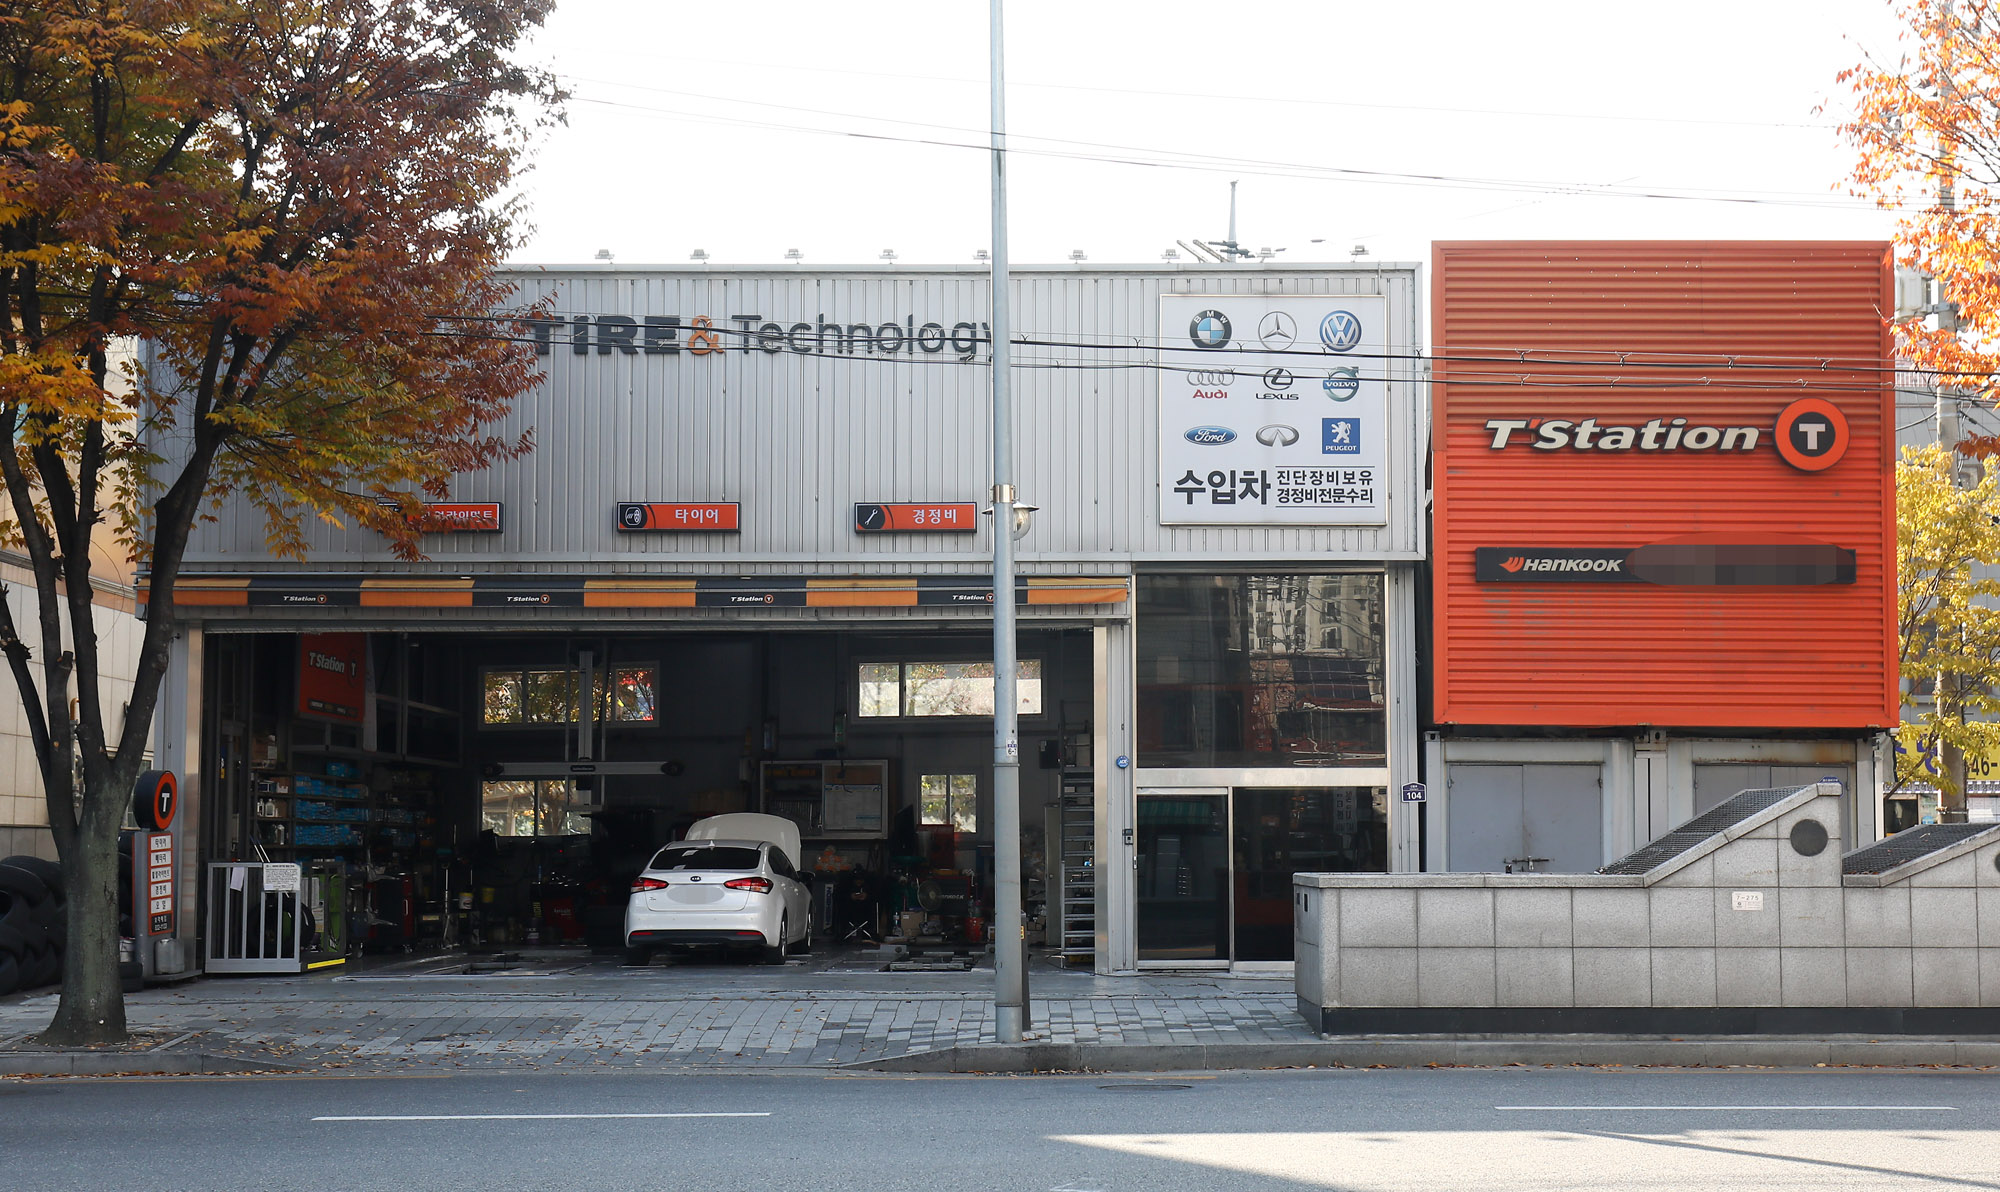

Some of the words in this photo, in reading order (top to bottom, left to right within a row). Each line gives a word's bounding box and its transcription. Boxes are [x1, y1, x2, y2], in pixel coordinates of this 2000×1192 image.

[1194, 310, 1228, 324] BMW
[525, 315, 681, 355] TIRE
[1193, 389, 1228, 399] Audi
[1194, 428, 1227, 442] Ford
[1798, 423, 1826, 450] T
[1277, 470, 1374, 486] 진단장비보유
[1174, 469, 1271, 505] 수입차
[675, 508, 719, 524] 타이어
[912, 508, 958, 525] 경정비
[161, 792, 170, 812] T
[1406, 791, 1422, 800] 104
